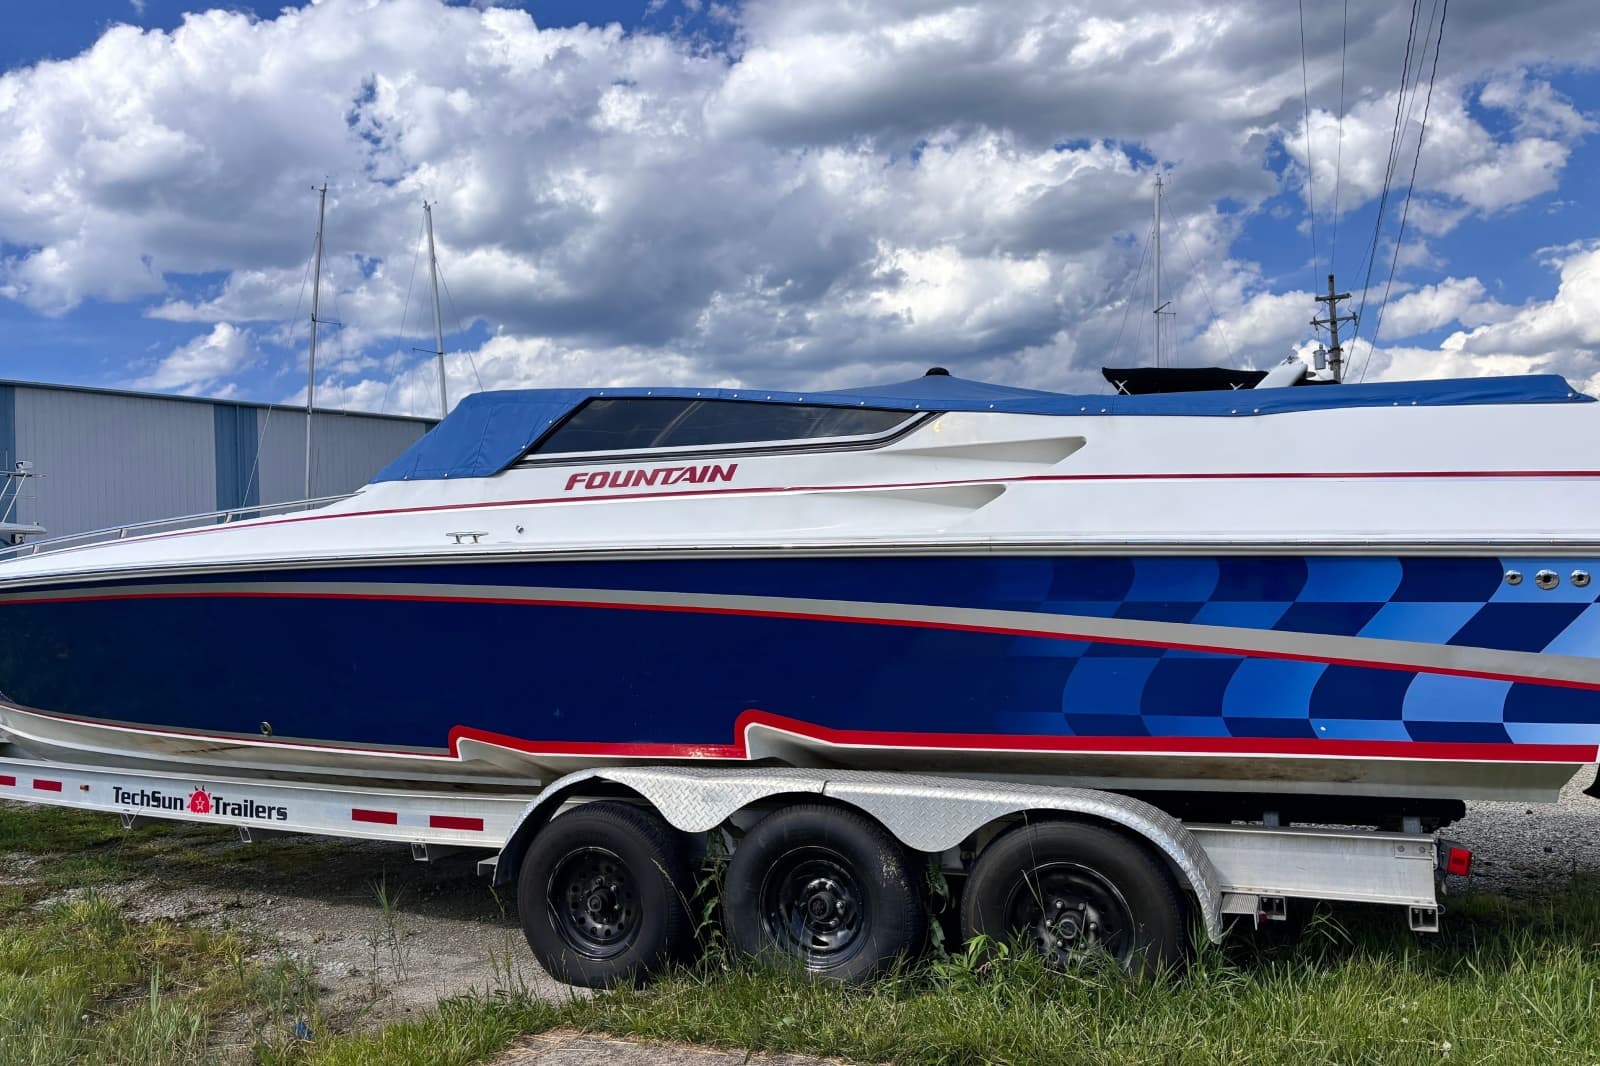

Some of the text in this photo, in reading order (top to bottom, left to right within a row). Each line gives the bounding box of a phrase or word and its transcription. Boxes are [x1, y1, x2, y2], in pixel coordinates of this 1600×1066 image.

[564, 463, 739, 491] FOUNTAIN
[113, 786, 288, 821] TechSun Trailers
